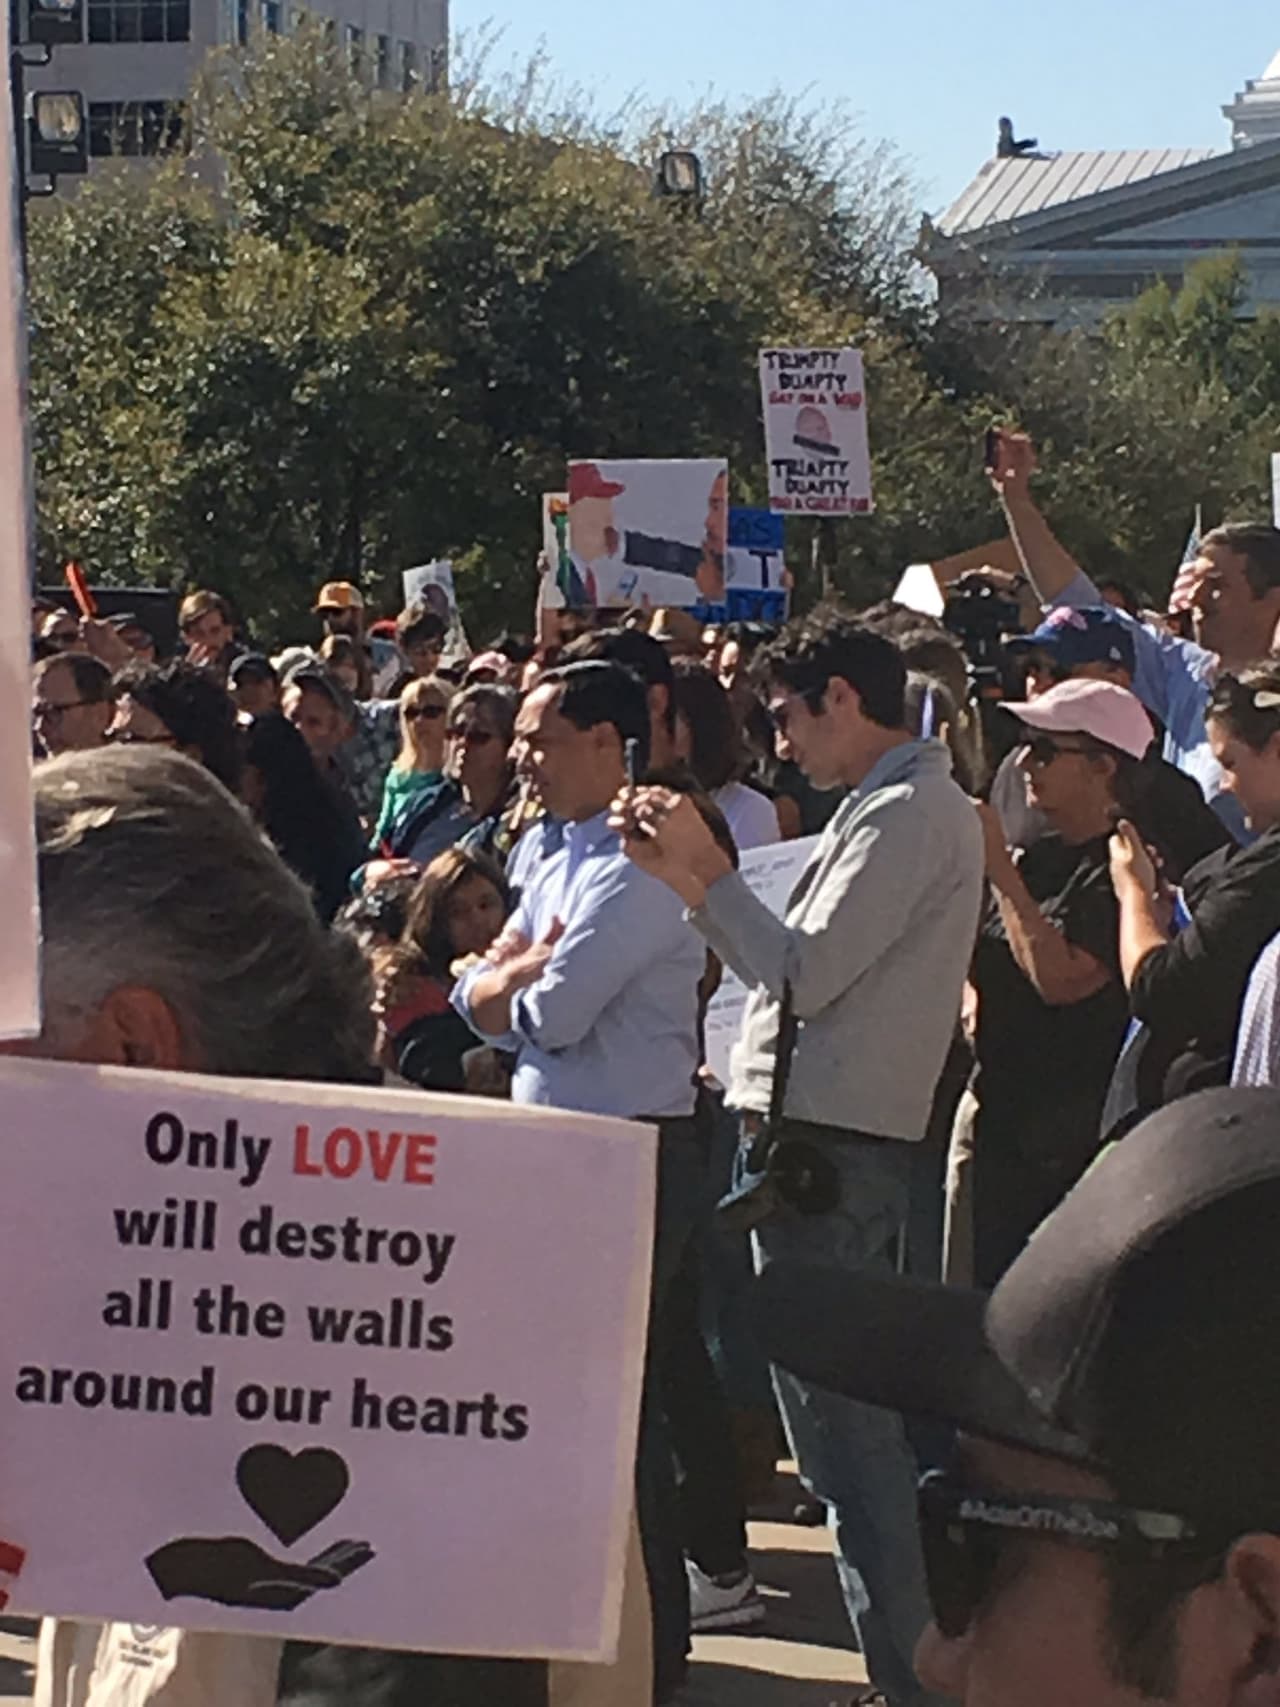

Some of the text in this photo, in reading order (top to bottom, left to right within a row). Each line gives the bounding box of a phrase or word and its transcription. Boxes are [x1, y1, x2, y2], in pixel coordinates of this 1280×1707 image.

[144, 1111, 438, 1188] Only LOVE
[113, 1197, 456, 1285] will destroy
[101, 1278, 455, 1352] all the walls
[14, 1365, 529, 1442] around our hearts
